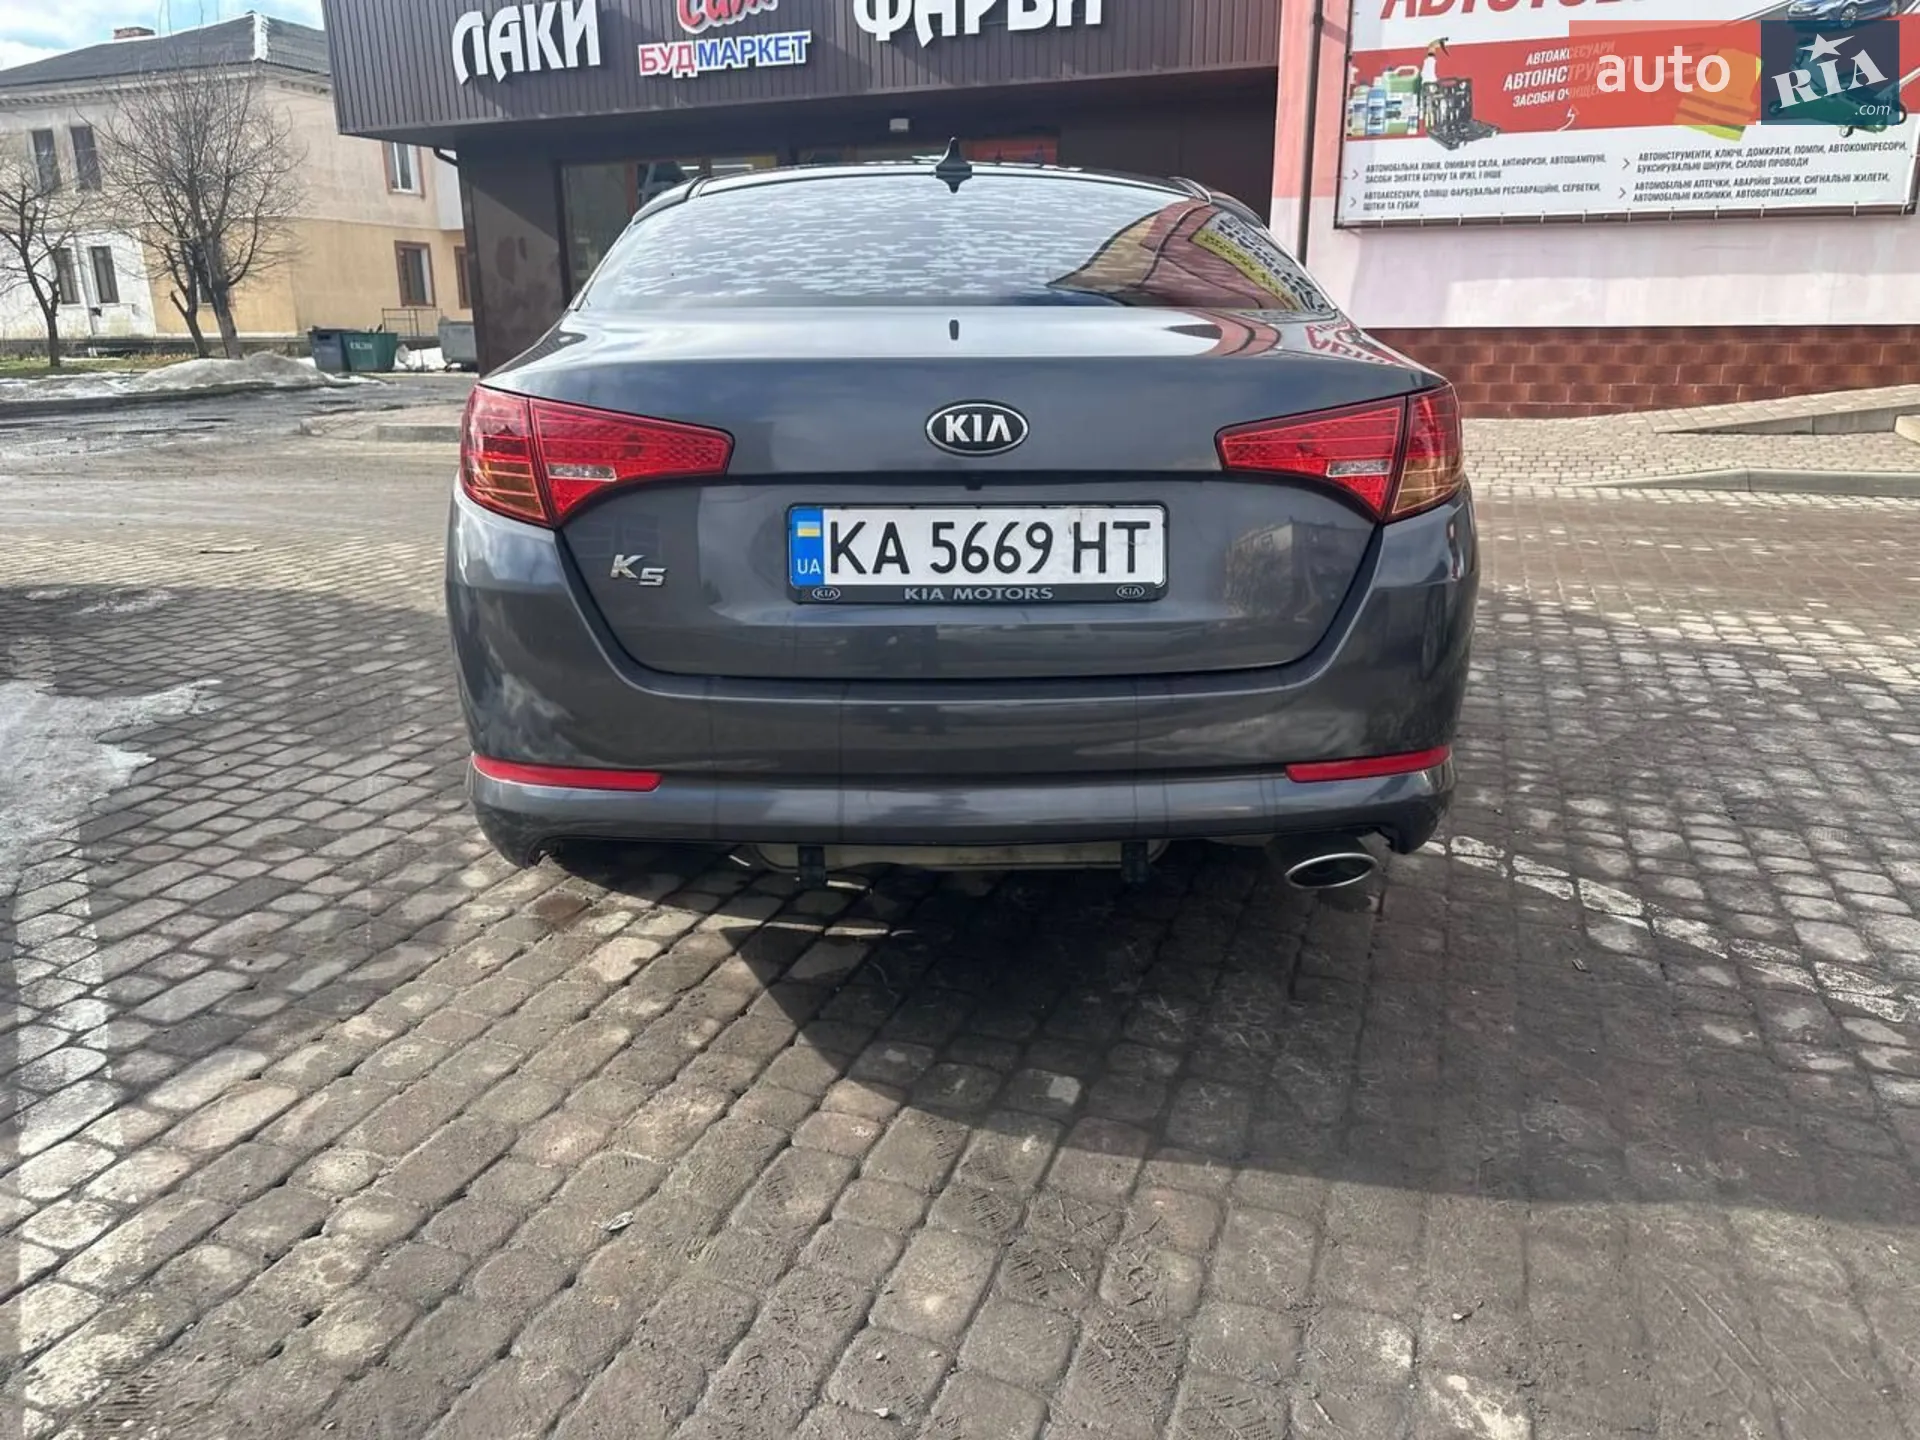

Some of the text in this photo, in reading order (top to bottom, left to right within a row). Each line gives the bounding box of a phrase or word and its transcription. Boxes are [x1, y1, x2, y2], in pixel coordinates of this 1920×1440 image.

[452, 0, 602, 85] ЛАКИ
[638, 31, 811, 78] БУДМАРКЕТ
[944, 414, 1013, 443] KIA
[929, 520, 1054, 576] 5669
[610, 554, 667, 586] K5
[797, 559, 822, 576] UA
[816, 588, 836, 599] KIA
[904, 586, 1054, 601] KIA MOTORS
[1120, 585, 1142, 597] KIA
